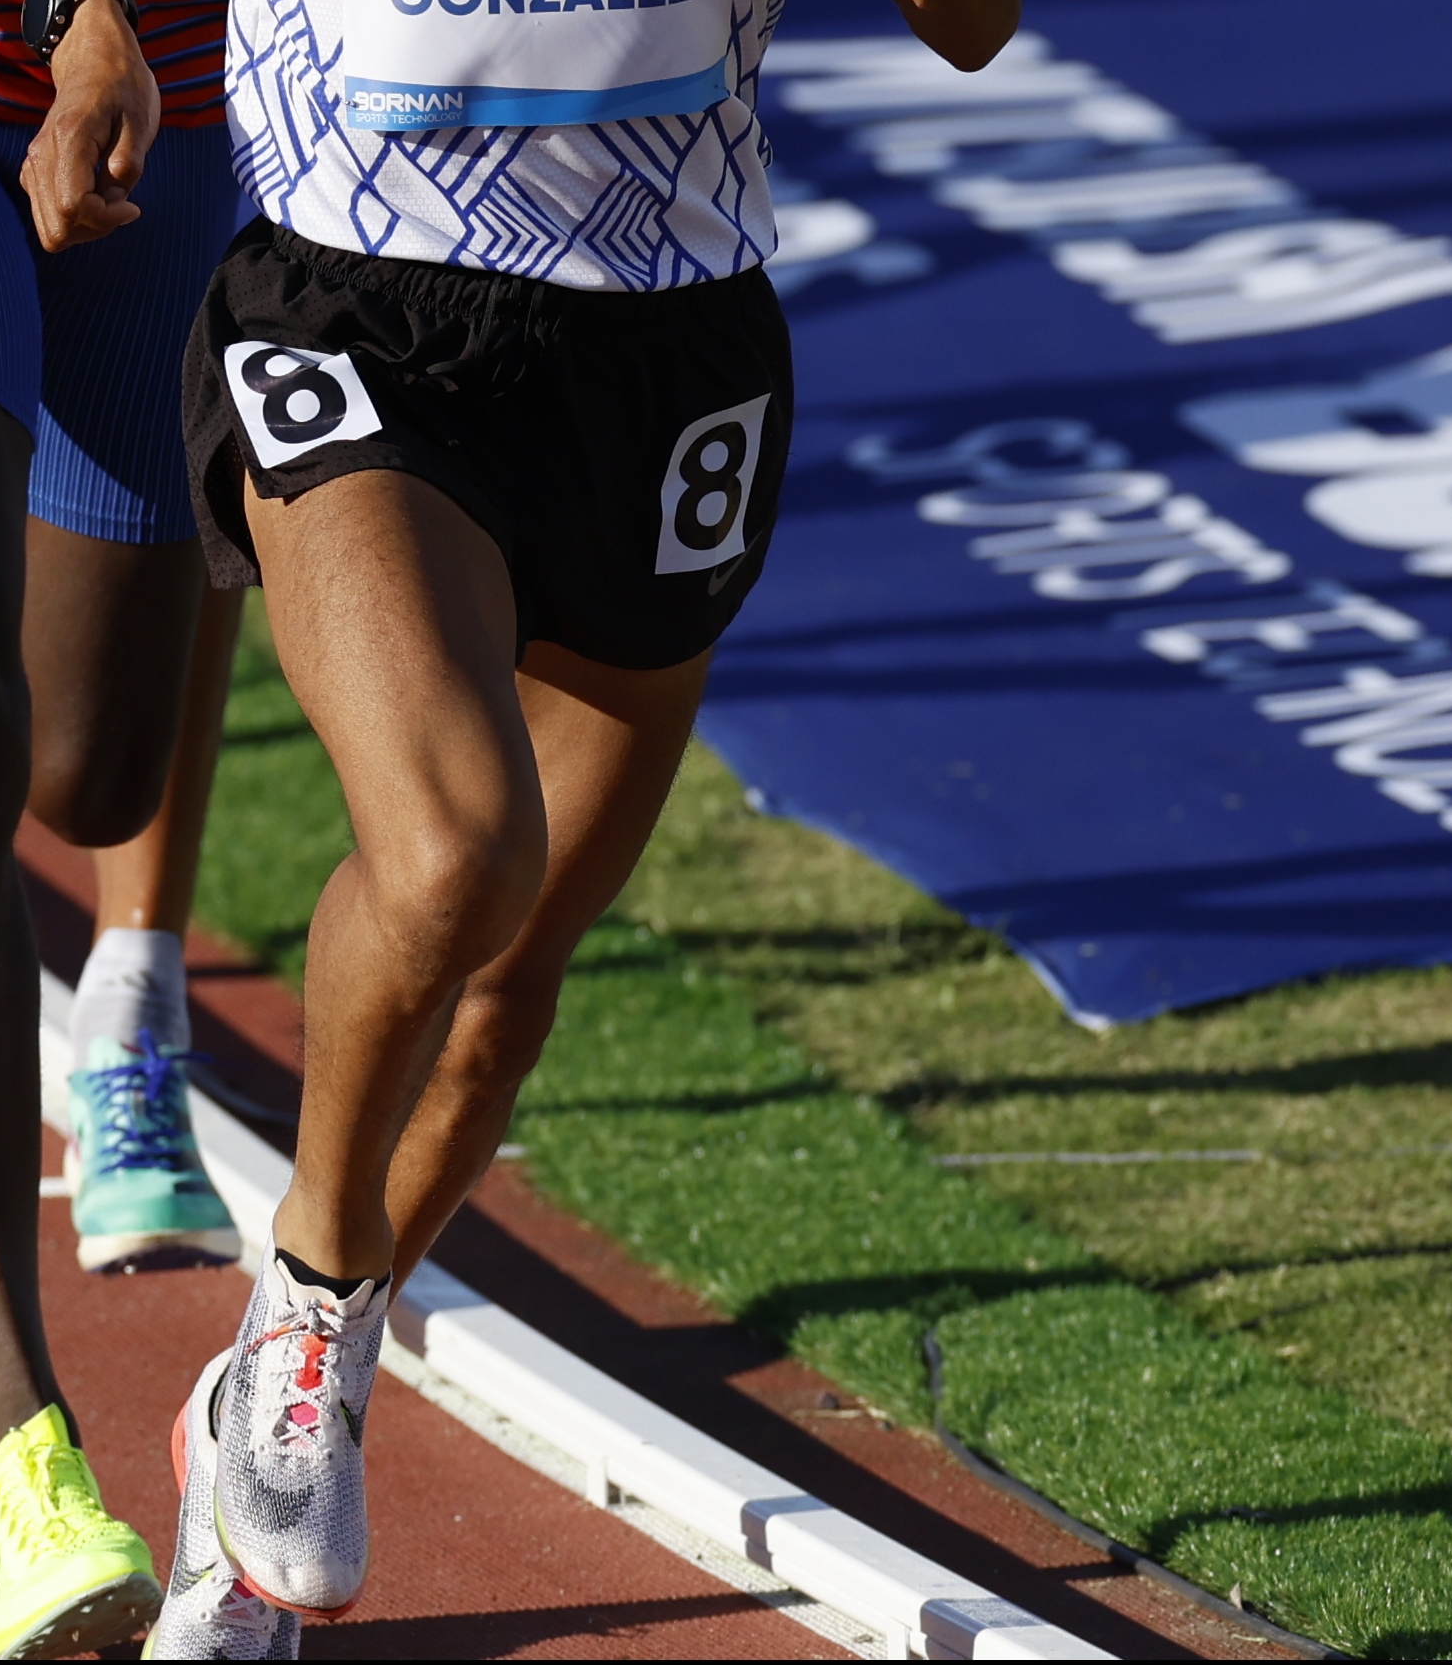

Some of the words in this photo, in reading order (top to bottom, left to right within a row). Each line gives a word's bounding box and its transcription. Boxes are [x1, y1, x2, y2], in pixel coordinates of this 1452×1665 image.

[353, 91, 464, 113] BORNAN
[355, 112, 389, 124] SPORTS
[390, 112, 463, 125] TECHNOLOGY
[240, 347, 348, 445] 8
[673, 420, 747, 551] 8
[844, 415, 1294, 603] SPORTS
